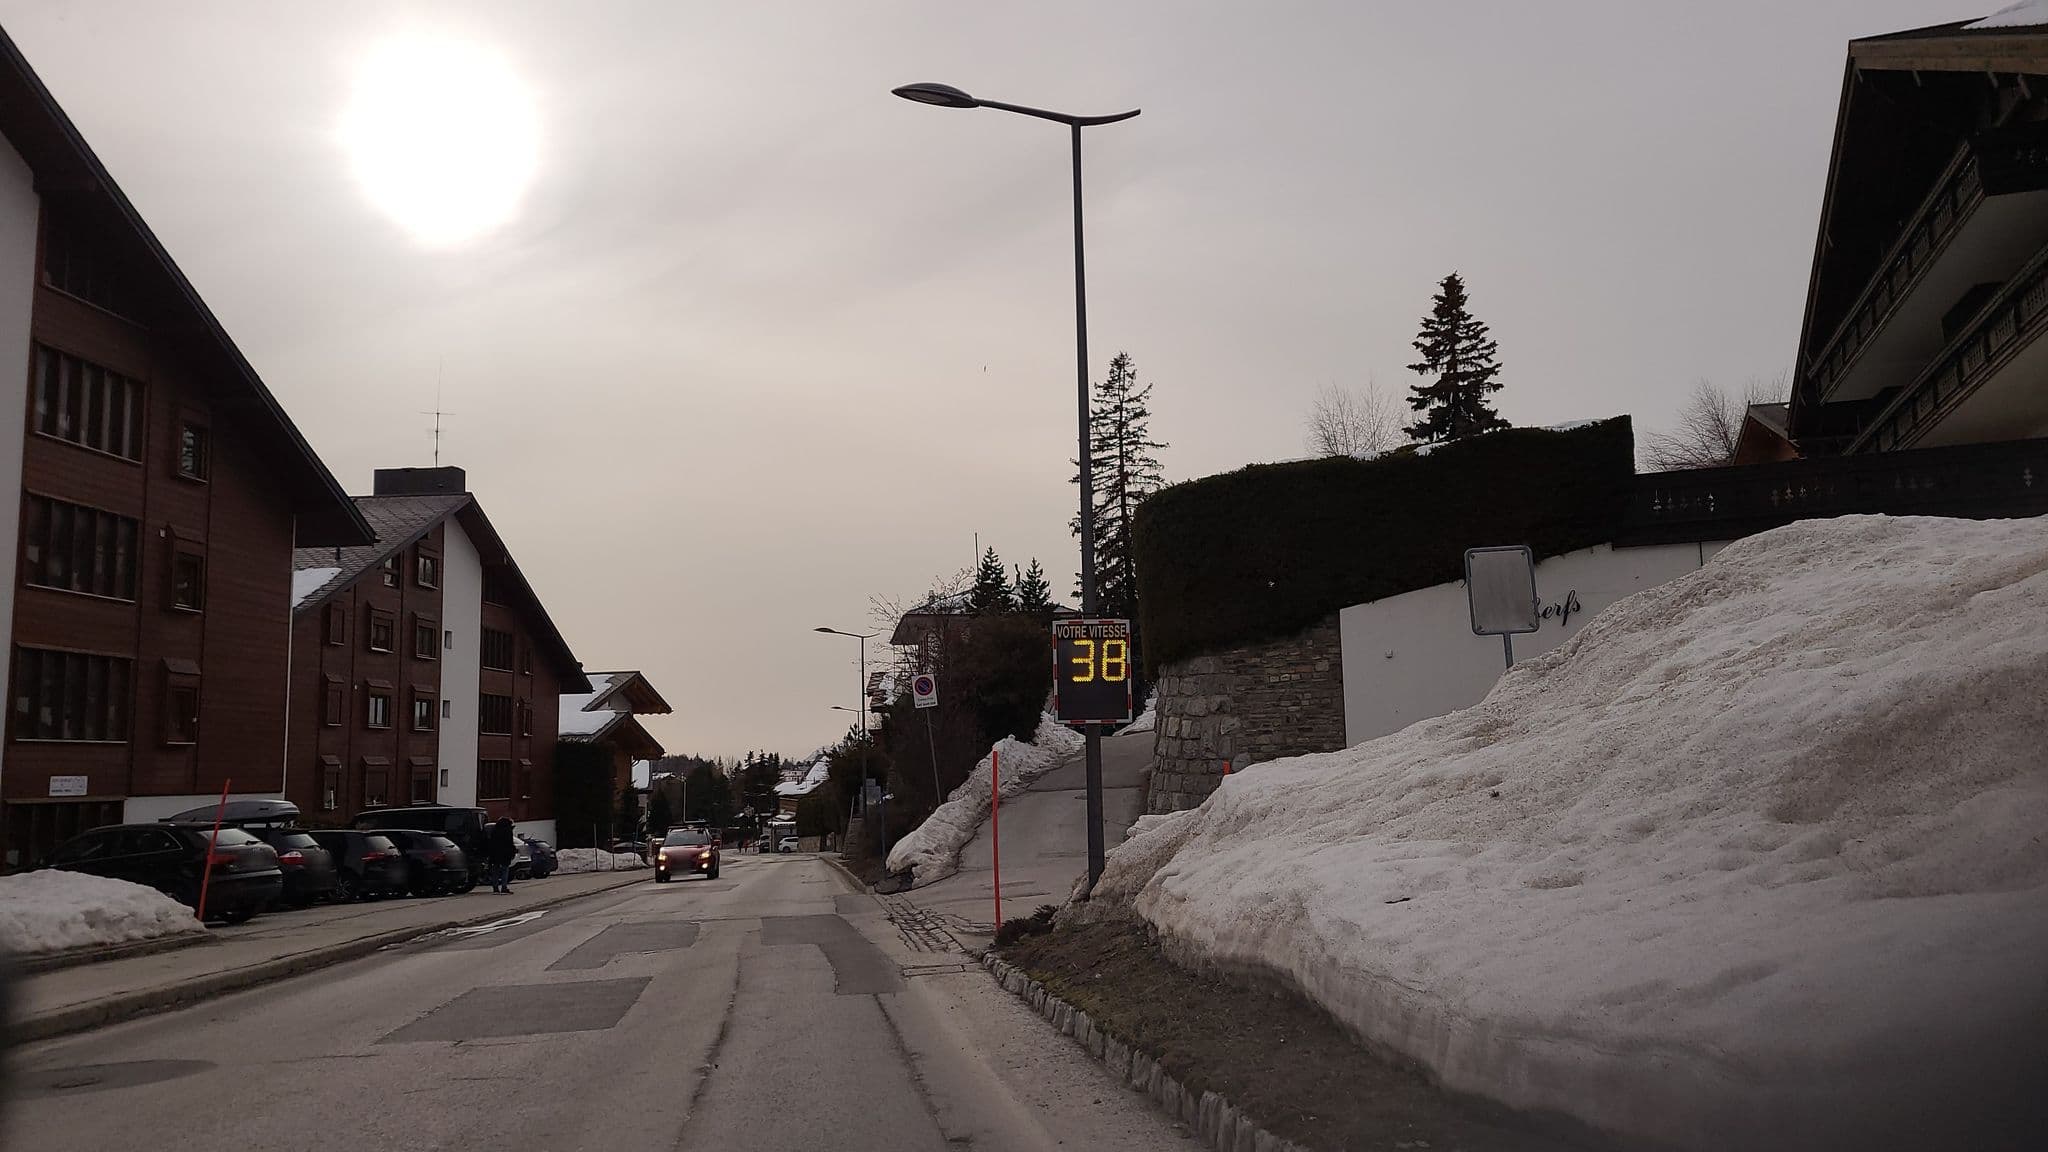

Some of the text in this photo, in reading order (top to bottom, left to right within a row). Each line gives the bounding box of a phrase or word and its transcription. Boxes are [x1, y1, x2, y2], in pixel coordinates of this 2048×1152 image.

[1535, 589, 1581, 627] erfs
[1057, 625, 1126, 639] VOTRE VITESSE
[1072, 639, 1126, 682] 38
